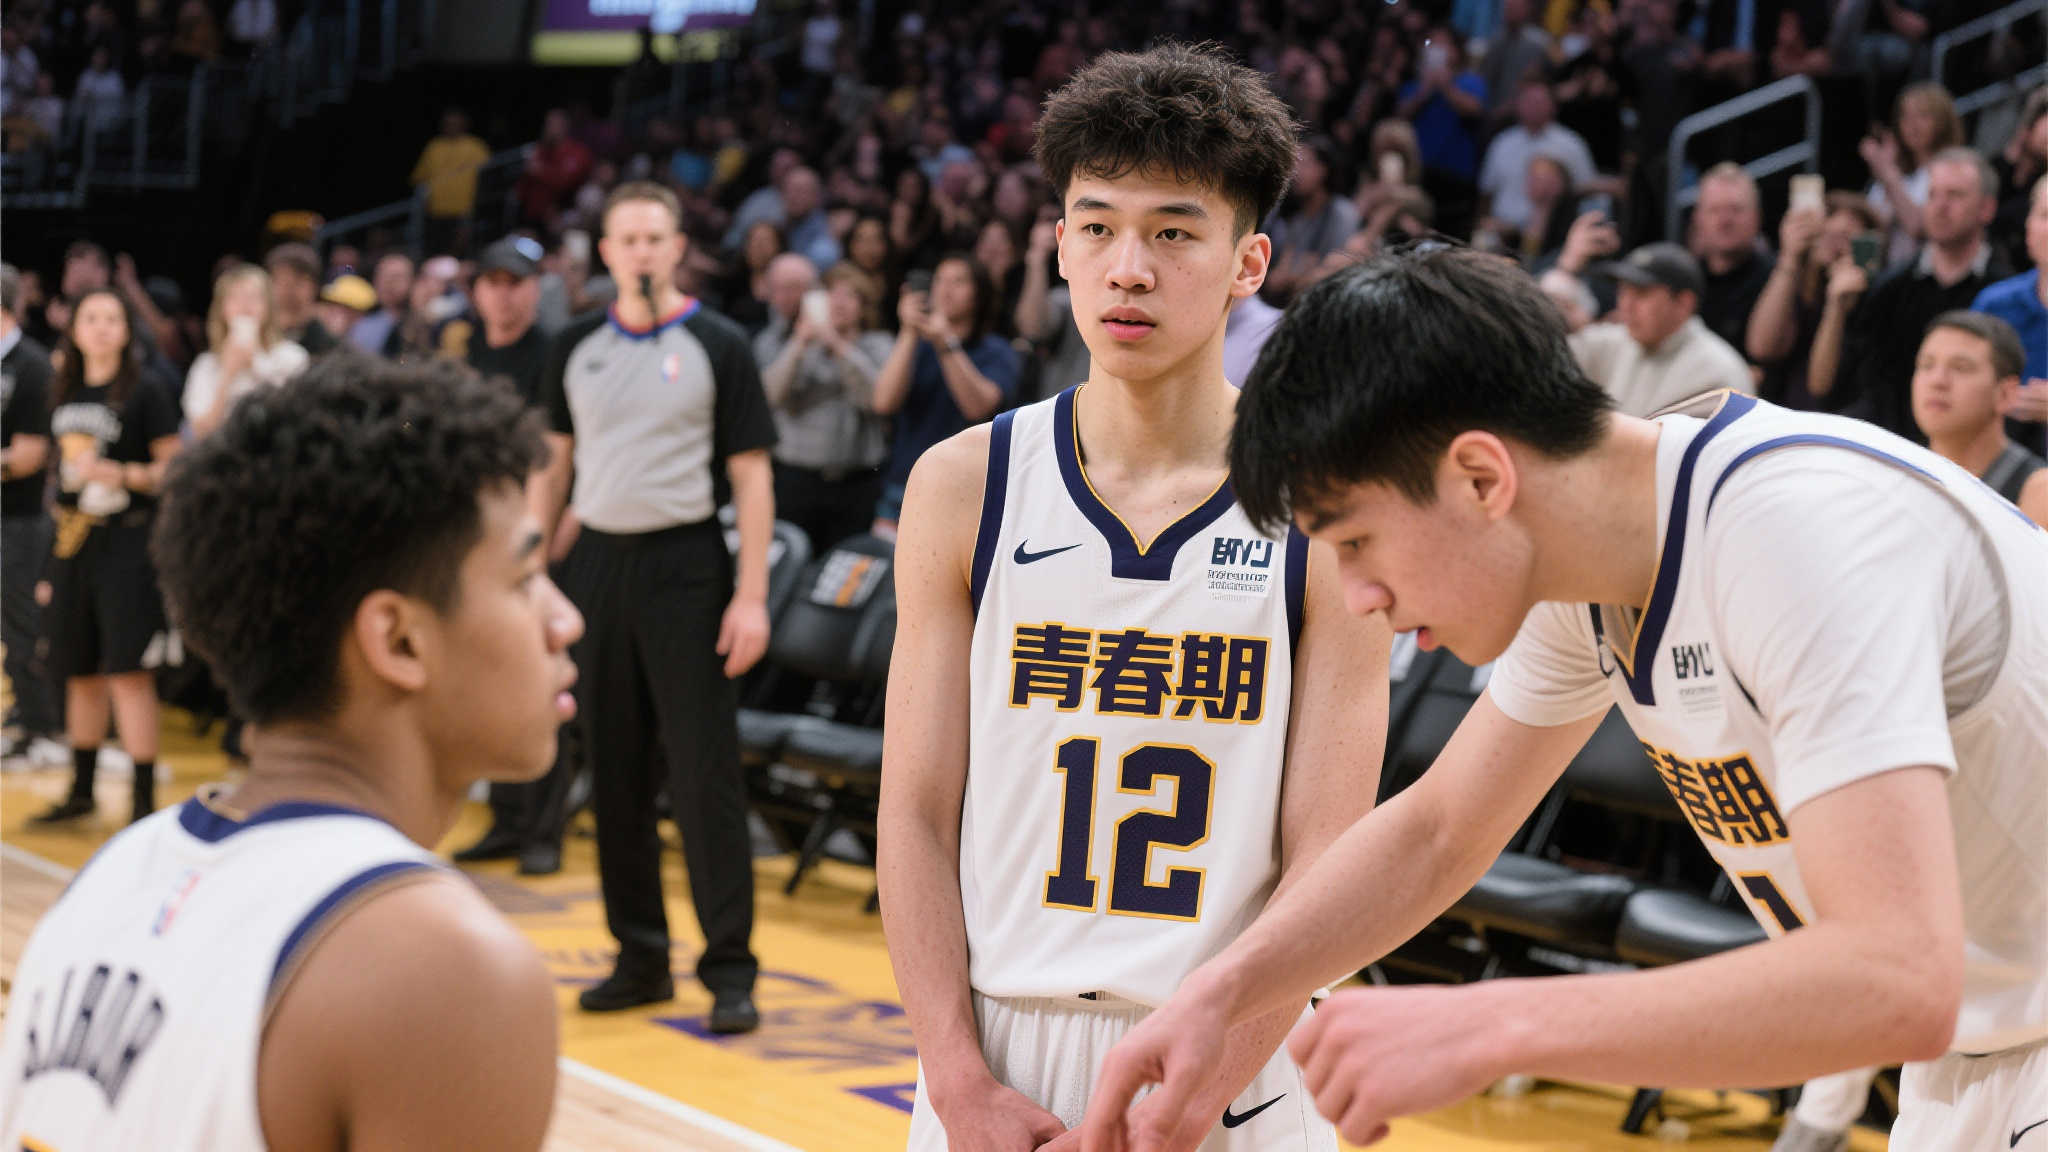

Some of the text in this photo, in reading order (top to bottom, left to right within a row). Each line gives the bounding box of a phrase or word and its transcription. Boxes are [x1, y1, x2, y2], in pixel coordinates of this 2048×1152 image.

[1008, 621, 1272, 725] 青春期
[1042, 736, 1217, 922] 12
[1638, 737, 1792, 848] 春期
